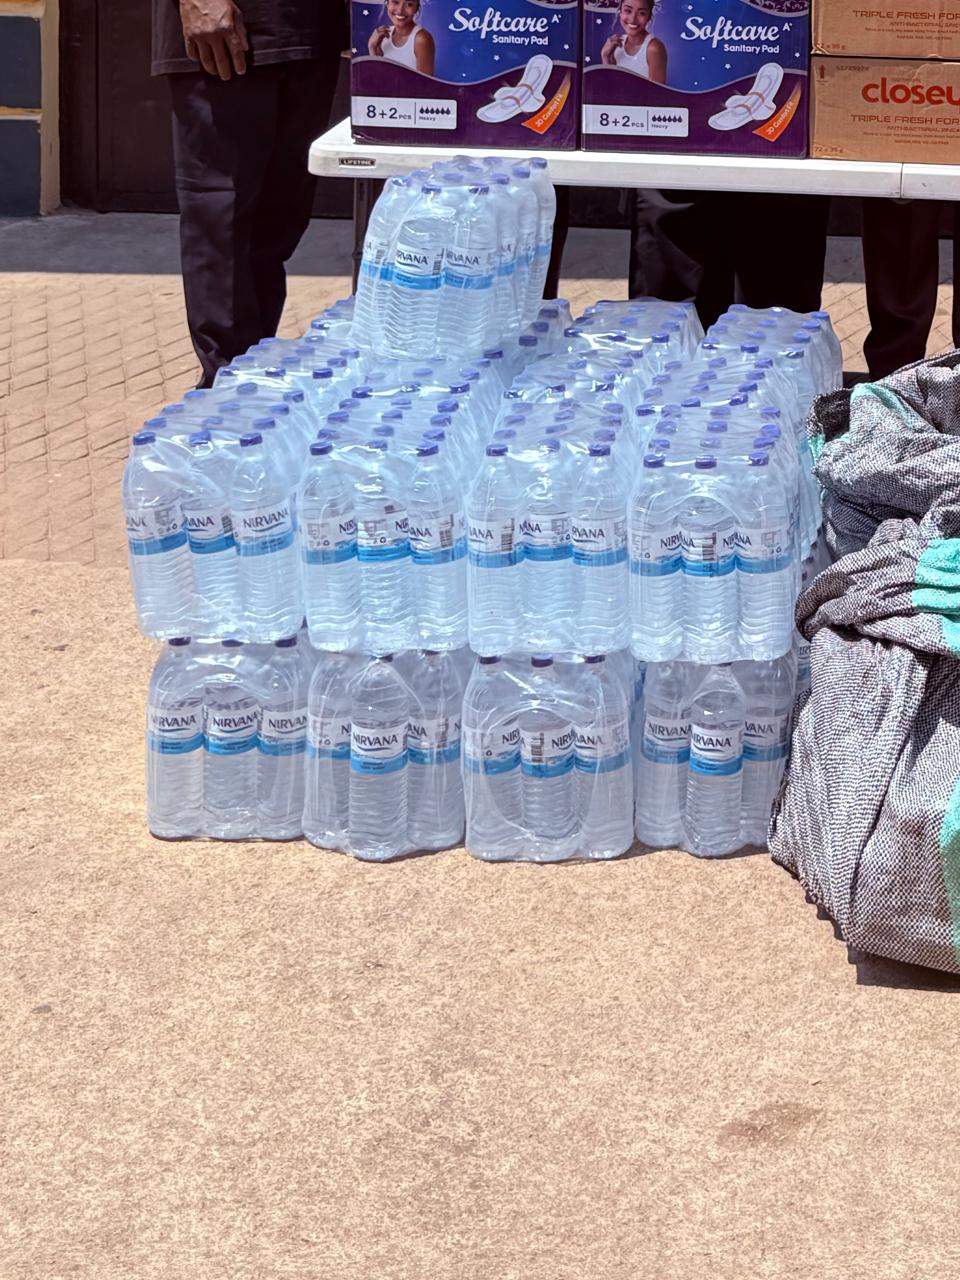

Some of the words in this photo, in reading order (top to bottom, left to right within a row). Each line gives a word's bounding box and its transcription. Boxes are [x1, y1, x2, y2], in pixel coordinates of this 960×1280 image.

[853, 10, 894, 19] TRIPLE
[897, 11, 936, 19] FRESH
[449, 8, 549, 39] Softcare
[680, 16, 779, 48] Softcare
[492, 35, 529, 45] Sanitary
[531, 36, 549, 45] Pad
[724, 44, 760, 54] Sanitary
[762, 45, 779, 53] Pad
[850, 114, 890, 124] TRIPLE
[895, 116, 933, 125] FRESH
[243, 508, 288, 528] NIRVANA
[213, 711, 258, 729] NIRVANA
[650, 723, 691, 737] NIRVANA
[352, 734, 398, 747] NIRVANA
